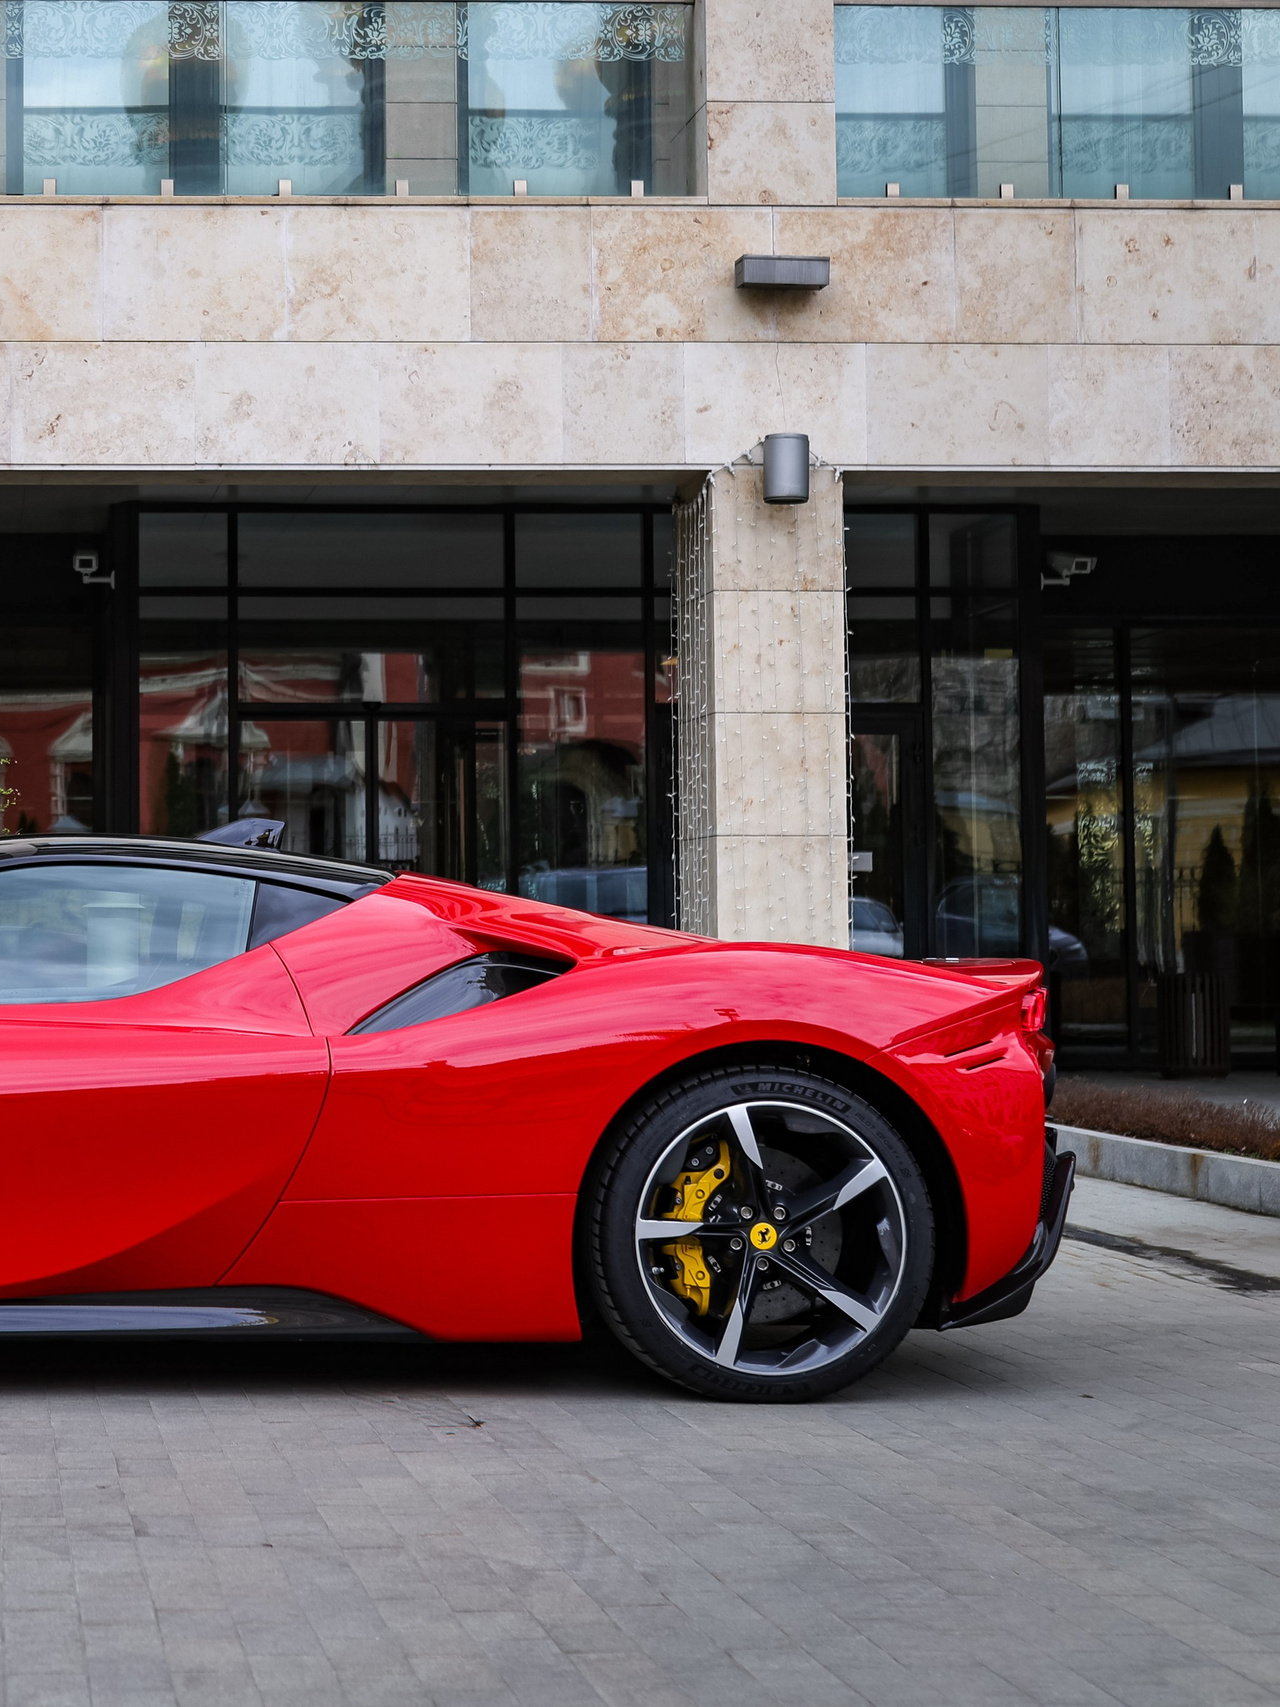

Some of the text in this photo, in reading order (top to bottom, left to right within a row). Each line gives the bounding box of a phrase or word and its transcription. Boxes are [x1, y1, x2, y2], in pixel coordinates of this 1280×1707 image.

[756, 1082, 847, 1111] MICHELIN
[854, 1112, 897, 1154] PILOT SPORT
[693, 1366, 784, 1394] MICHELIN
